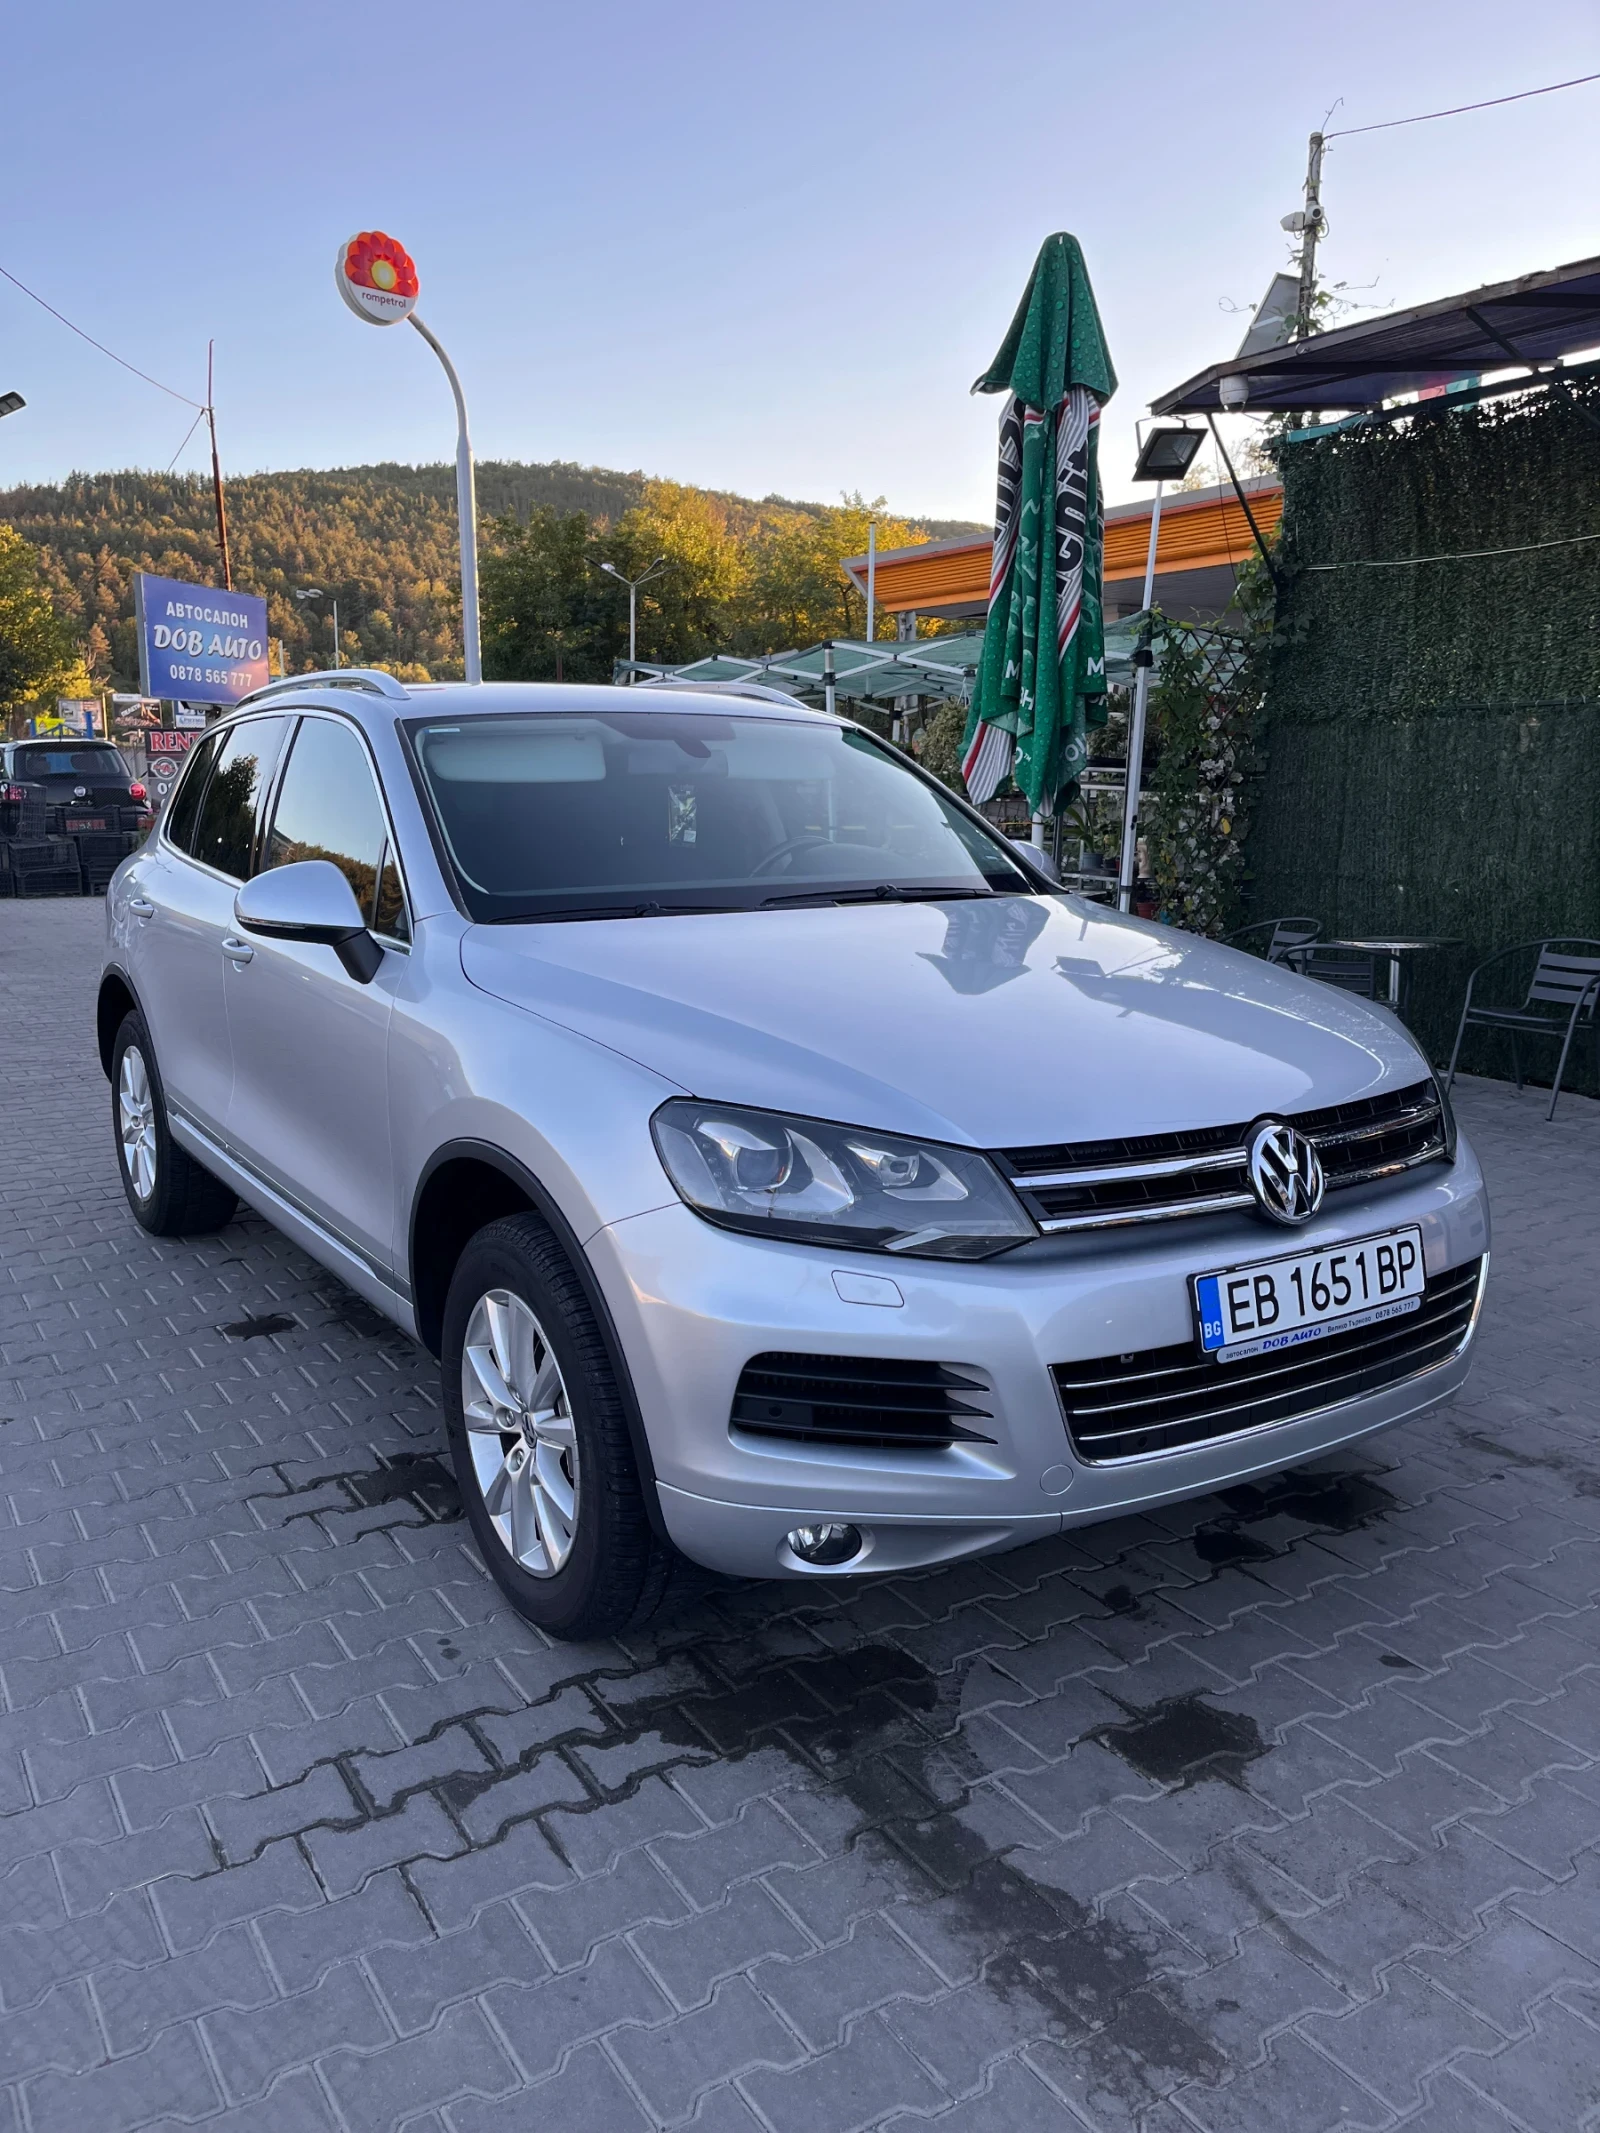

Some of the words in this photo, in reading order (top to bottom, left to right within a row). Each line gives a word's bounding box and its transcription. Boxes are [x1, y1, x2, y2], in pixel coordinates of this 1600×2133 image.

[361, 291, 406, 308] rompetrol
[166, 601, 248, 629] АВТОСАЛОН
[153, 624, 203, 657] DOB
[208, 634, 262, 660] AUTO
[170, 664, 202, 682] 0878
[205, 668, 228, 685] 565
[231, 671, 252, 687] 777
[1226, 1273, 1280, 1334] EB
[1290, 1251, 1369, 1317] 1651
[1376, 1240, 1416, 1295] BP
[1204, 1320, 1221, 1339] BG
[1225, 1346, 1259, 1360] автосалон
[1262, 1336, 1289, 1350] DOB
[1291, 1326, 1322, 1343] AUTO
[1375, 1310, 1390, 1320] 0878
[1391, 1305, 1402, 1315] 565
[1403, 1301, 1414, 1311] 777
